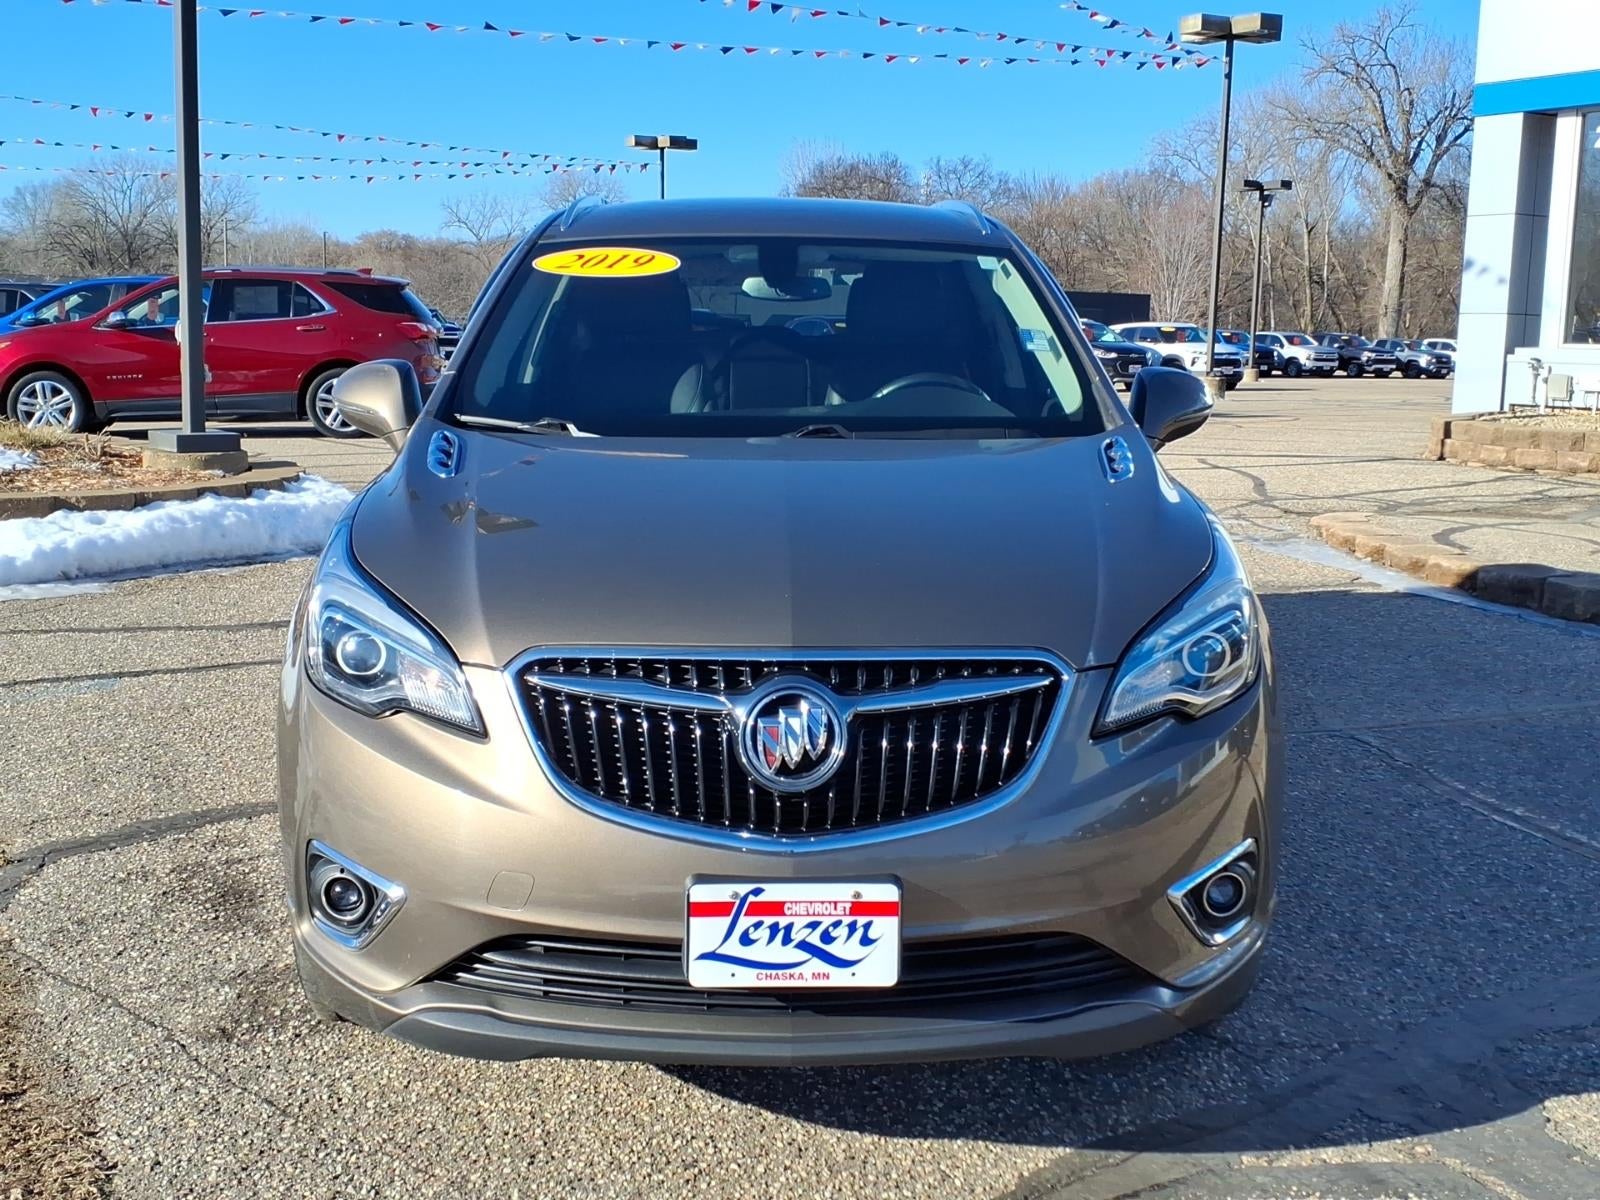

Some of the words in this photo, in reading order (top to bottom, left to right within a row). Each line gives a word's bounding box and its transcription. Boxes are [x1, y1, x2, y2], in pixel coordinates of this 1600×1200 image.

[556, 254, 656, 269] 2019
[784, 902, 852, 916] CHEVROLET
[693, 886, 884, 971] Lenzen
[756, 972, 808, 981] CHASKA,
[811, 973, 831, 981] MN
